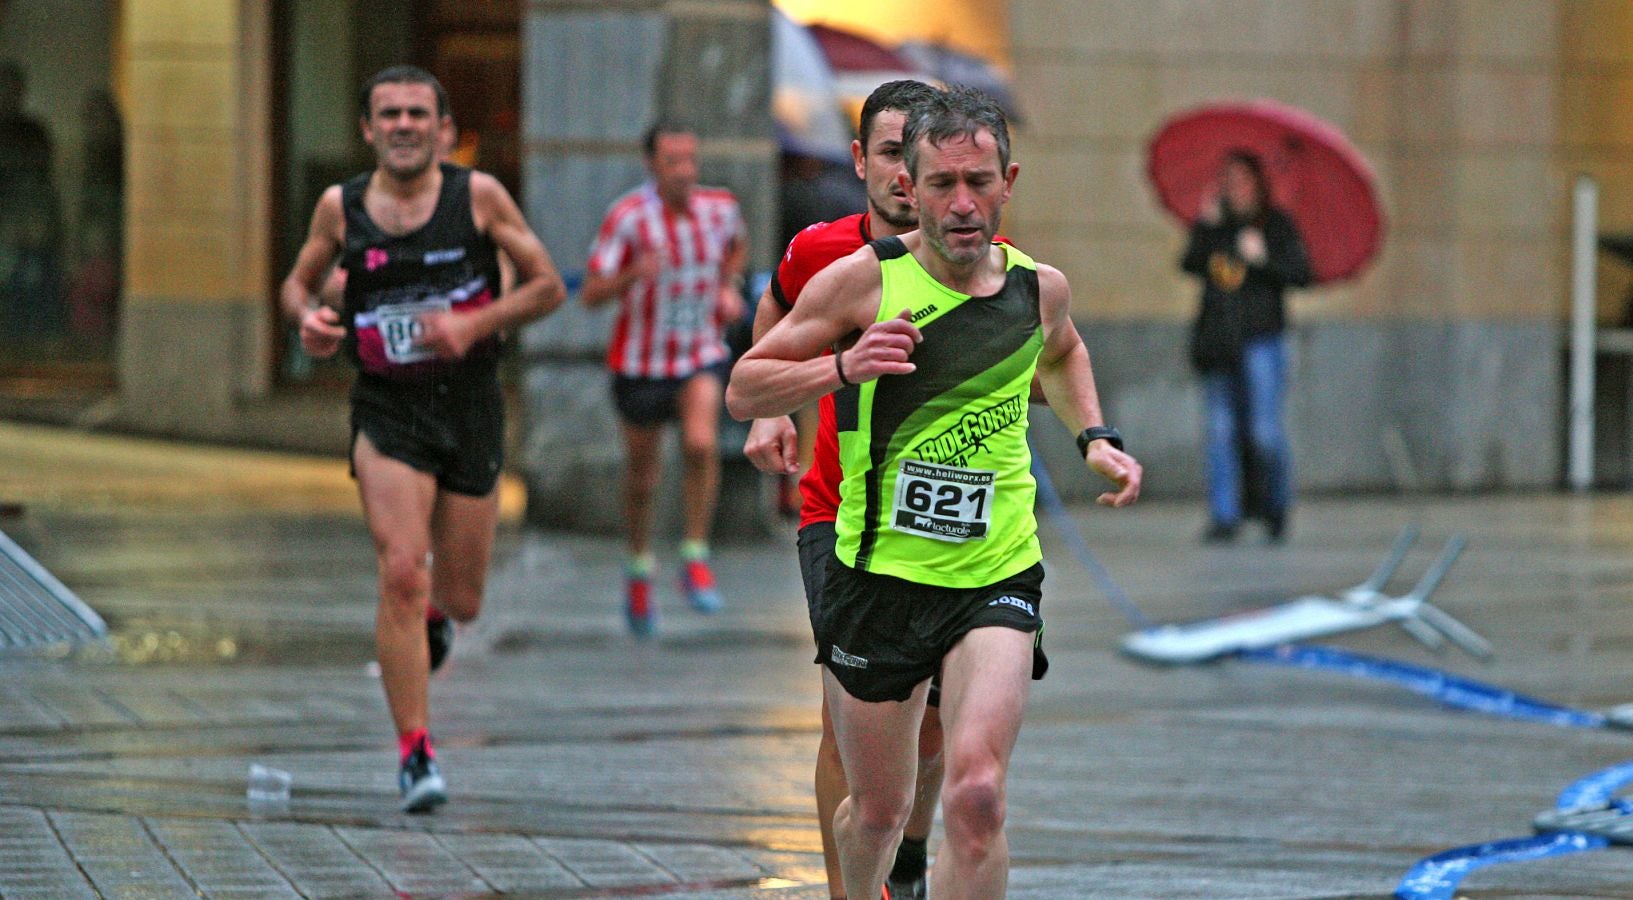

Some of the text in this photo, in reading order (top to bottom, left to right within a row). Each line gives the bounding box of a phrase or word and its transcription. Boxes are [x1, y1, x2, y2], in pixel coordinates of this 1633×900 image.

[911, 304, 938, 323] oma
[906, 464, 991, 481] www.heliworx.es
[906, 480, 986, 519] 621
